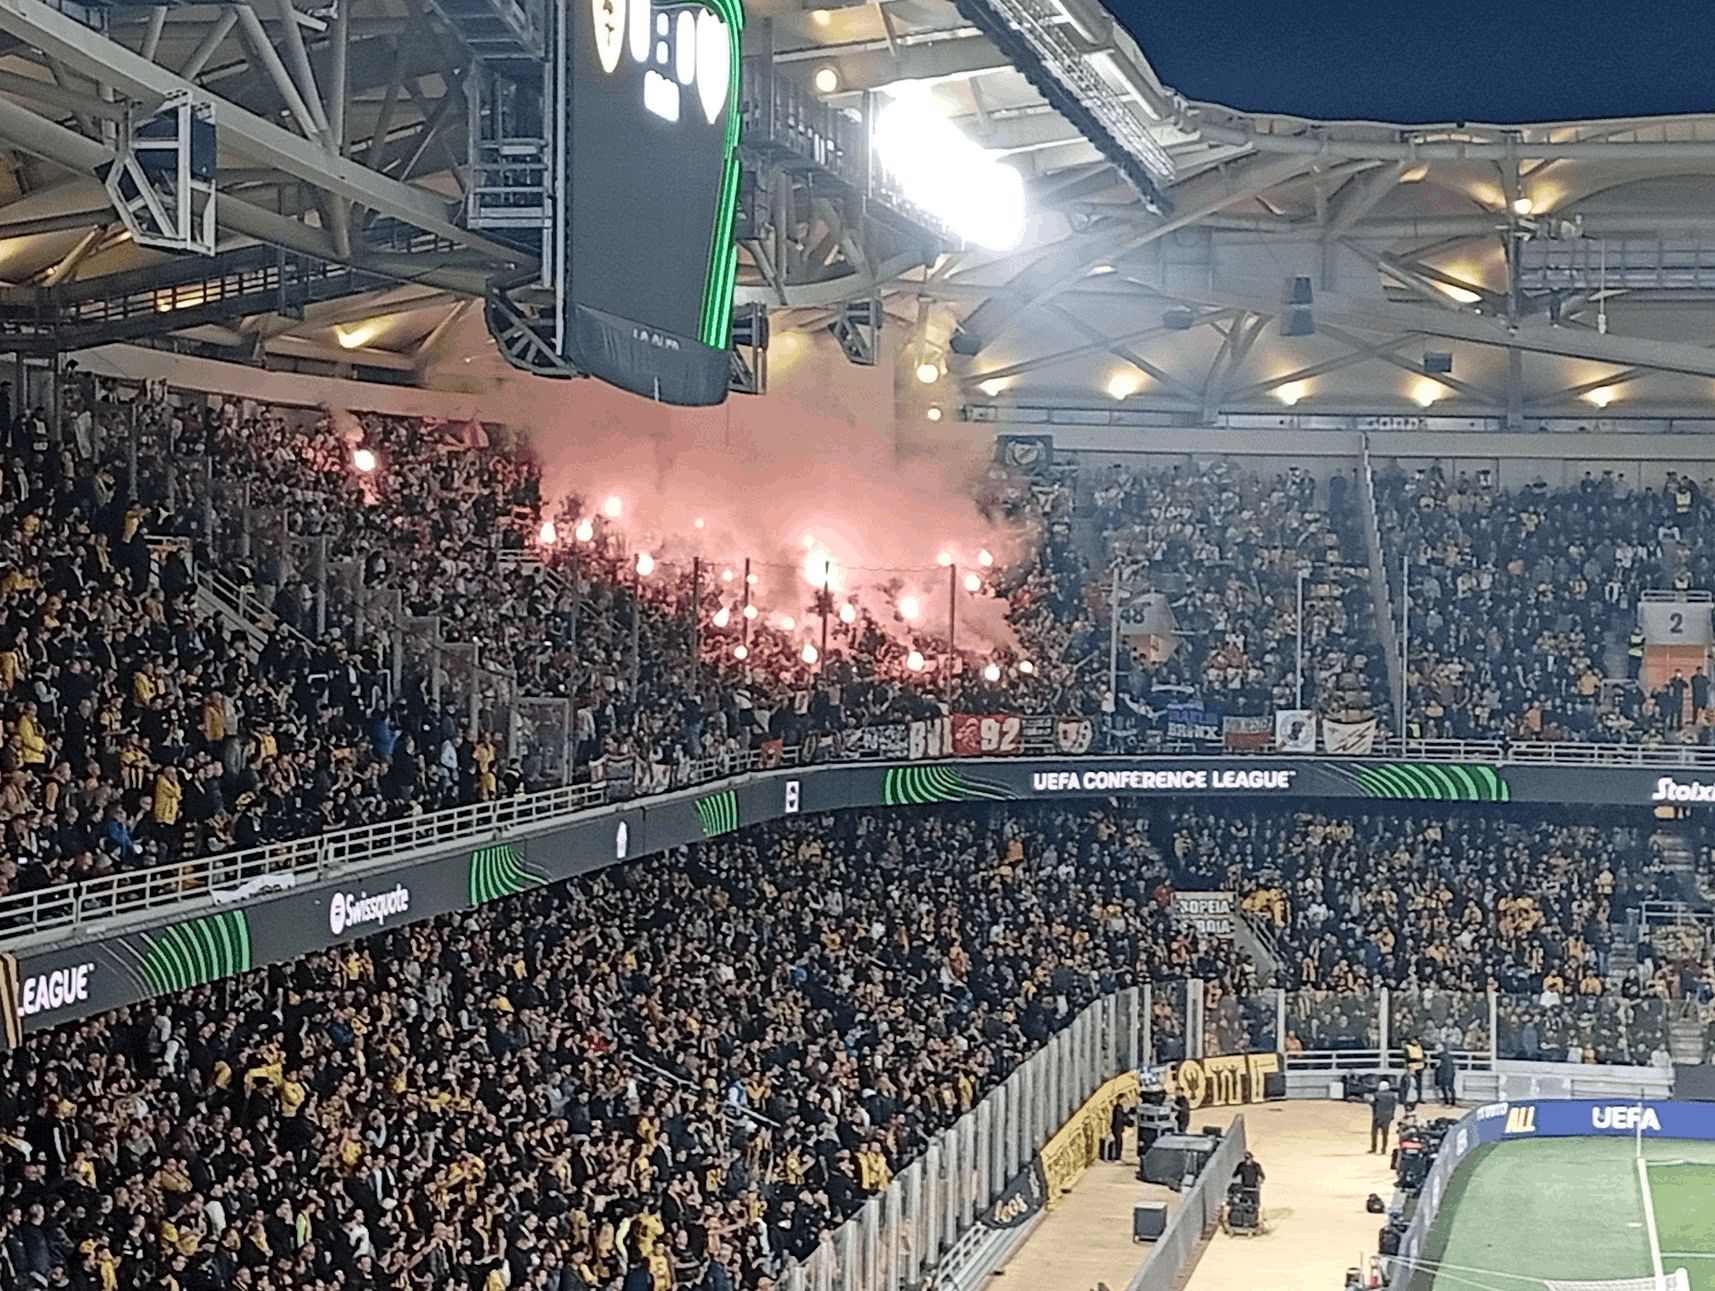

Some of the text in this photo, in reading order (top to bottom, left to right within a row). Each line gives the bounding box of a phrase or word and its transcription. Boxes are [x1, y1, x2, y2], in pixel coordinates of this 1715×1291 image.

[1670, 612, 1683, 633] 2
[980, 717, 1020, 751] 92
[1033, 771, 1290, 790] UEFA CONFERENCE LEAGUE
[1652, 777, 1715, 801] Stoix
[345, 883, 409, 927] Swissquote
[1505, 1106, 1536, 1133] ALL
[1592, 1107, 1661, 1131] UEFA
